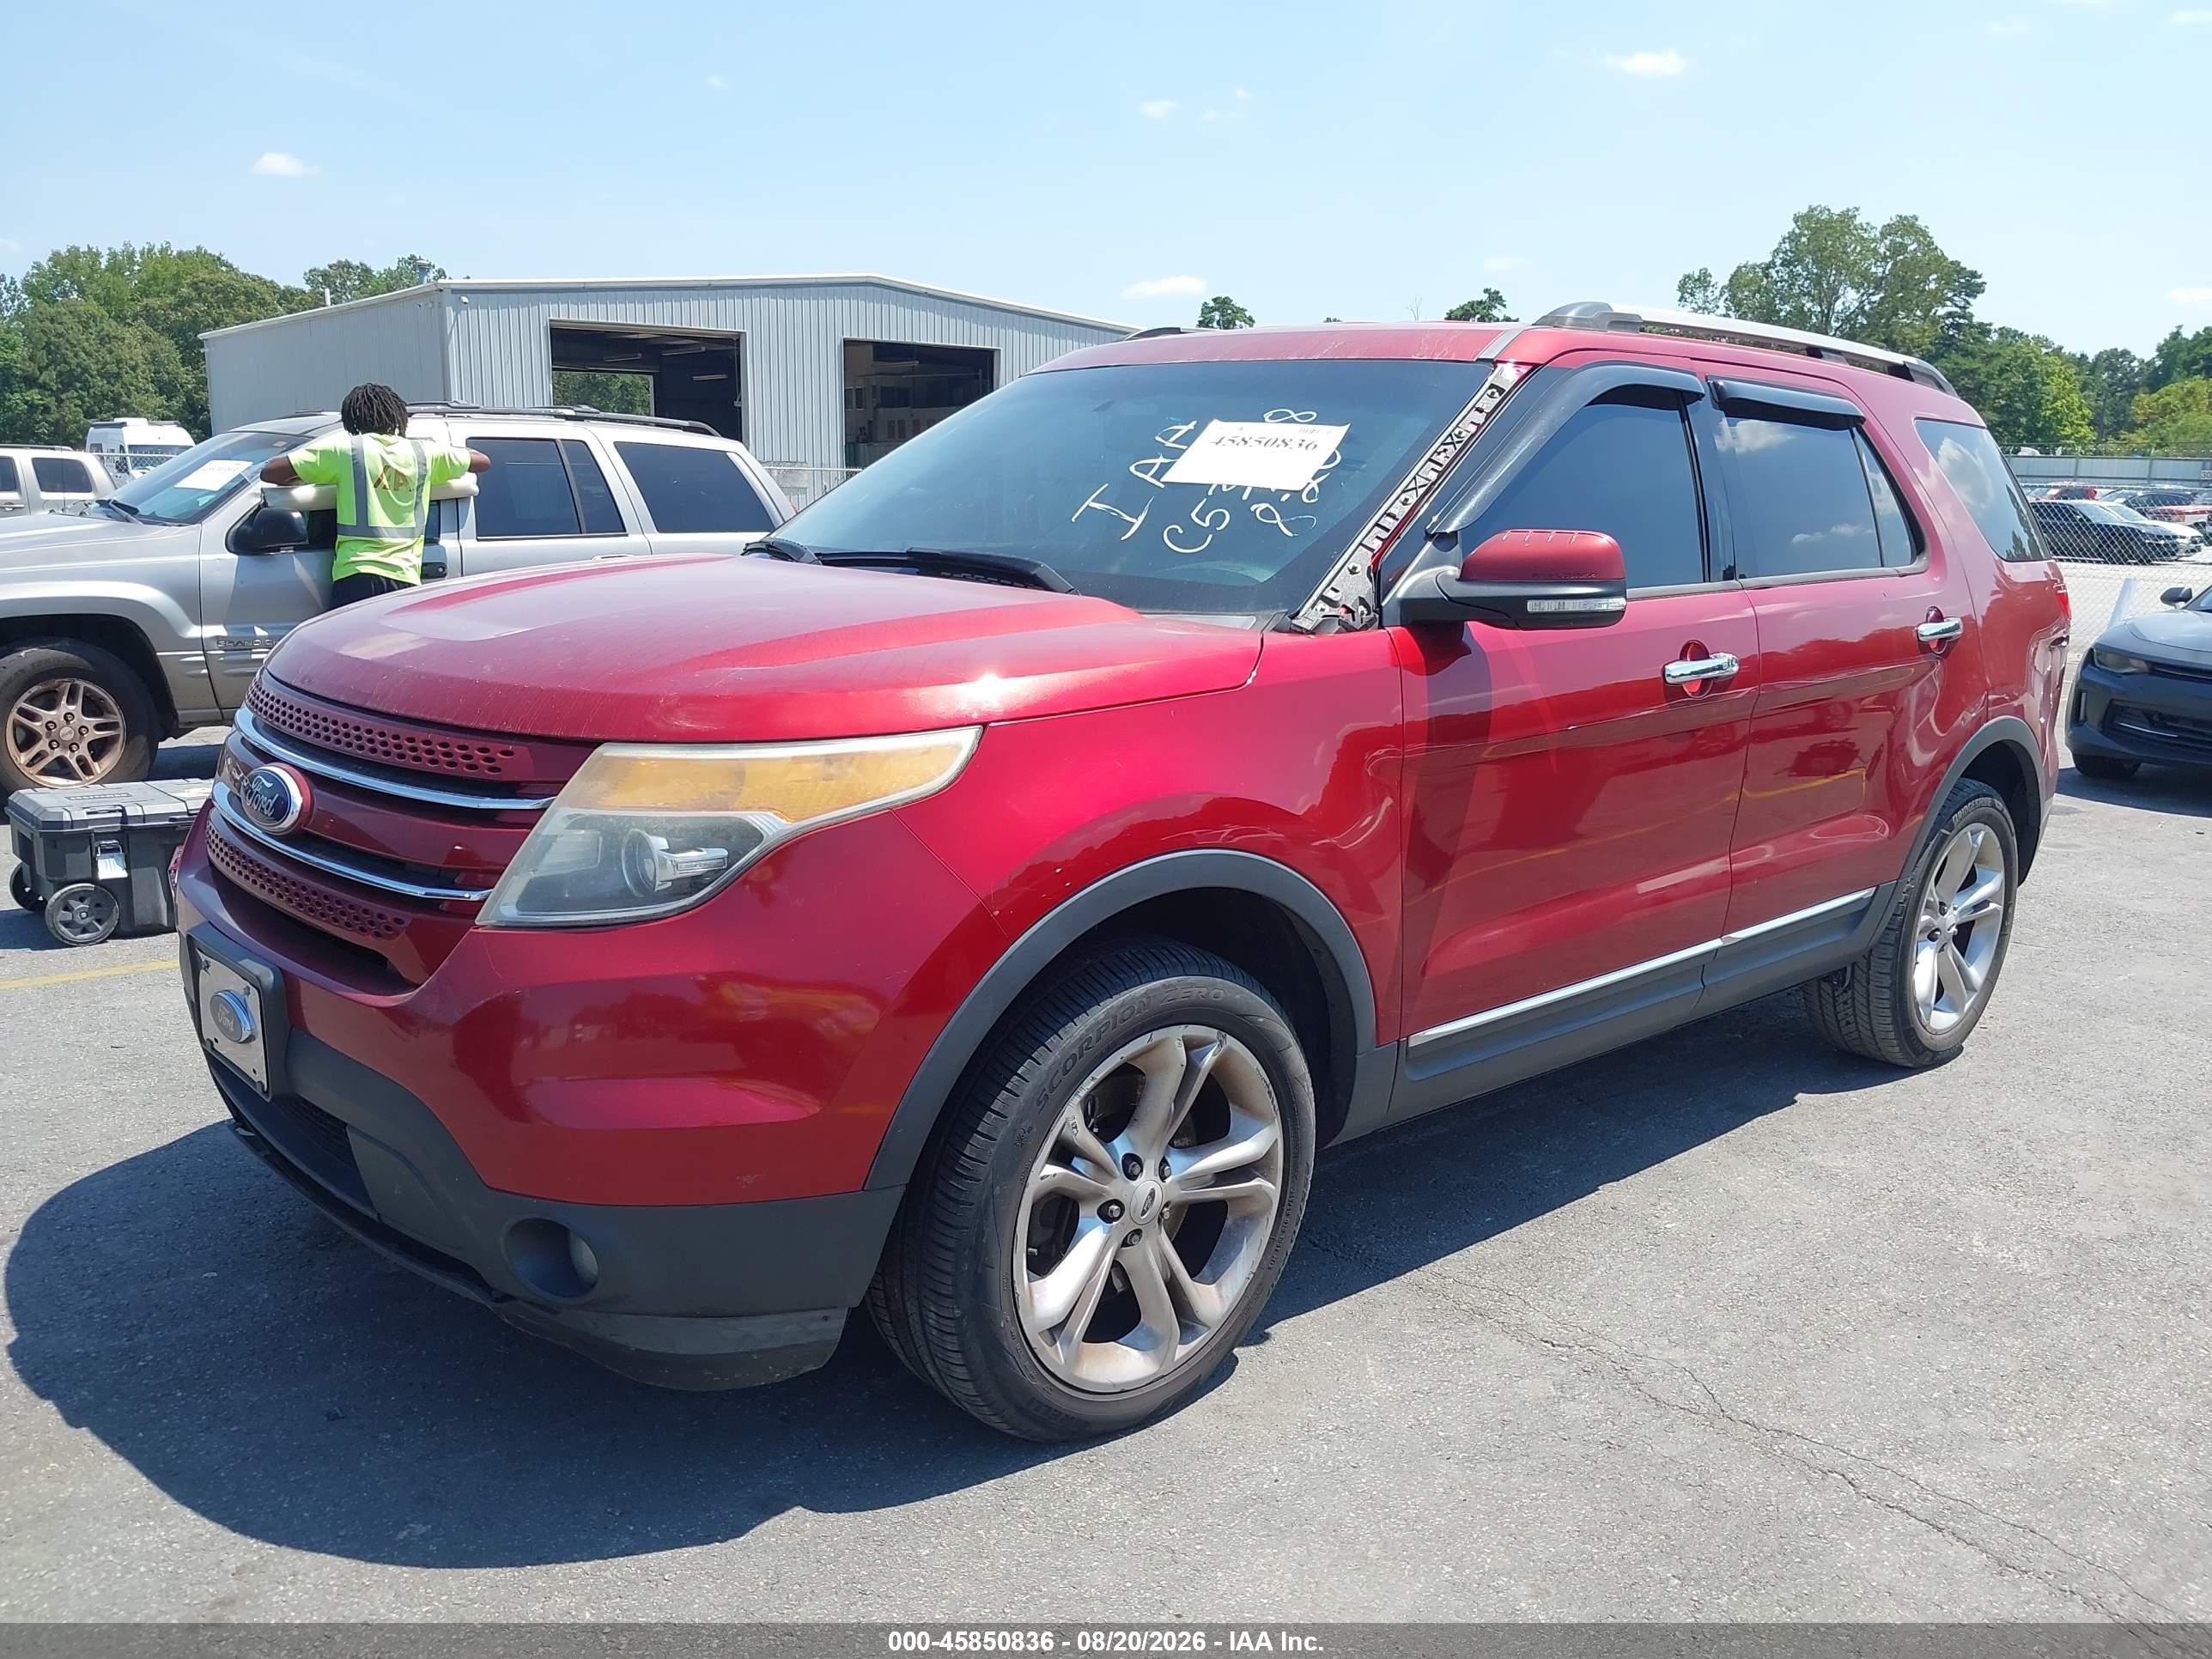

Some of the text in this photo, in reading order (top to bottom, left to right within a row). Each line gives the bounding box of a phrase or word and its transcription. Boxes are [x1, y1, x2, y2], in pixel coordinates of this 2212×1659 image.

[246, 775, 280, 817] Ford
[217, 1004, 234, 1031] Ford
[1036, 988, 1226, 1115] SCORPION ZERO
